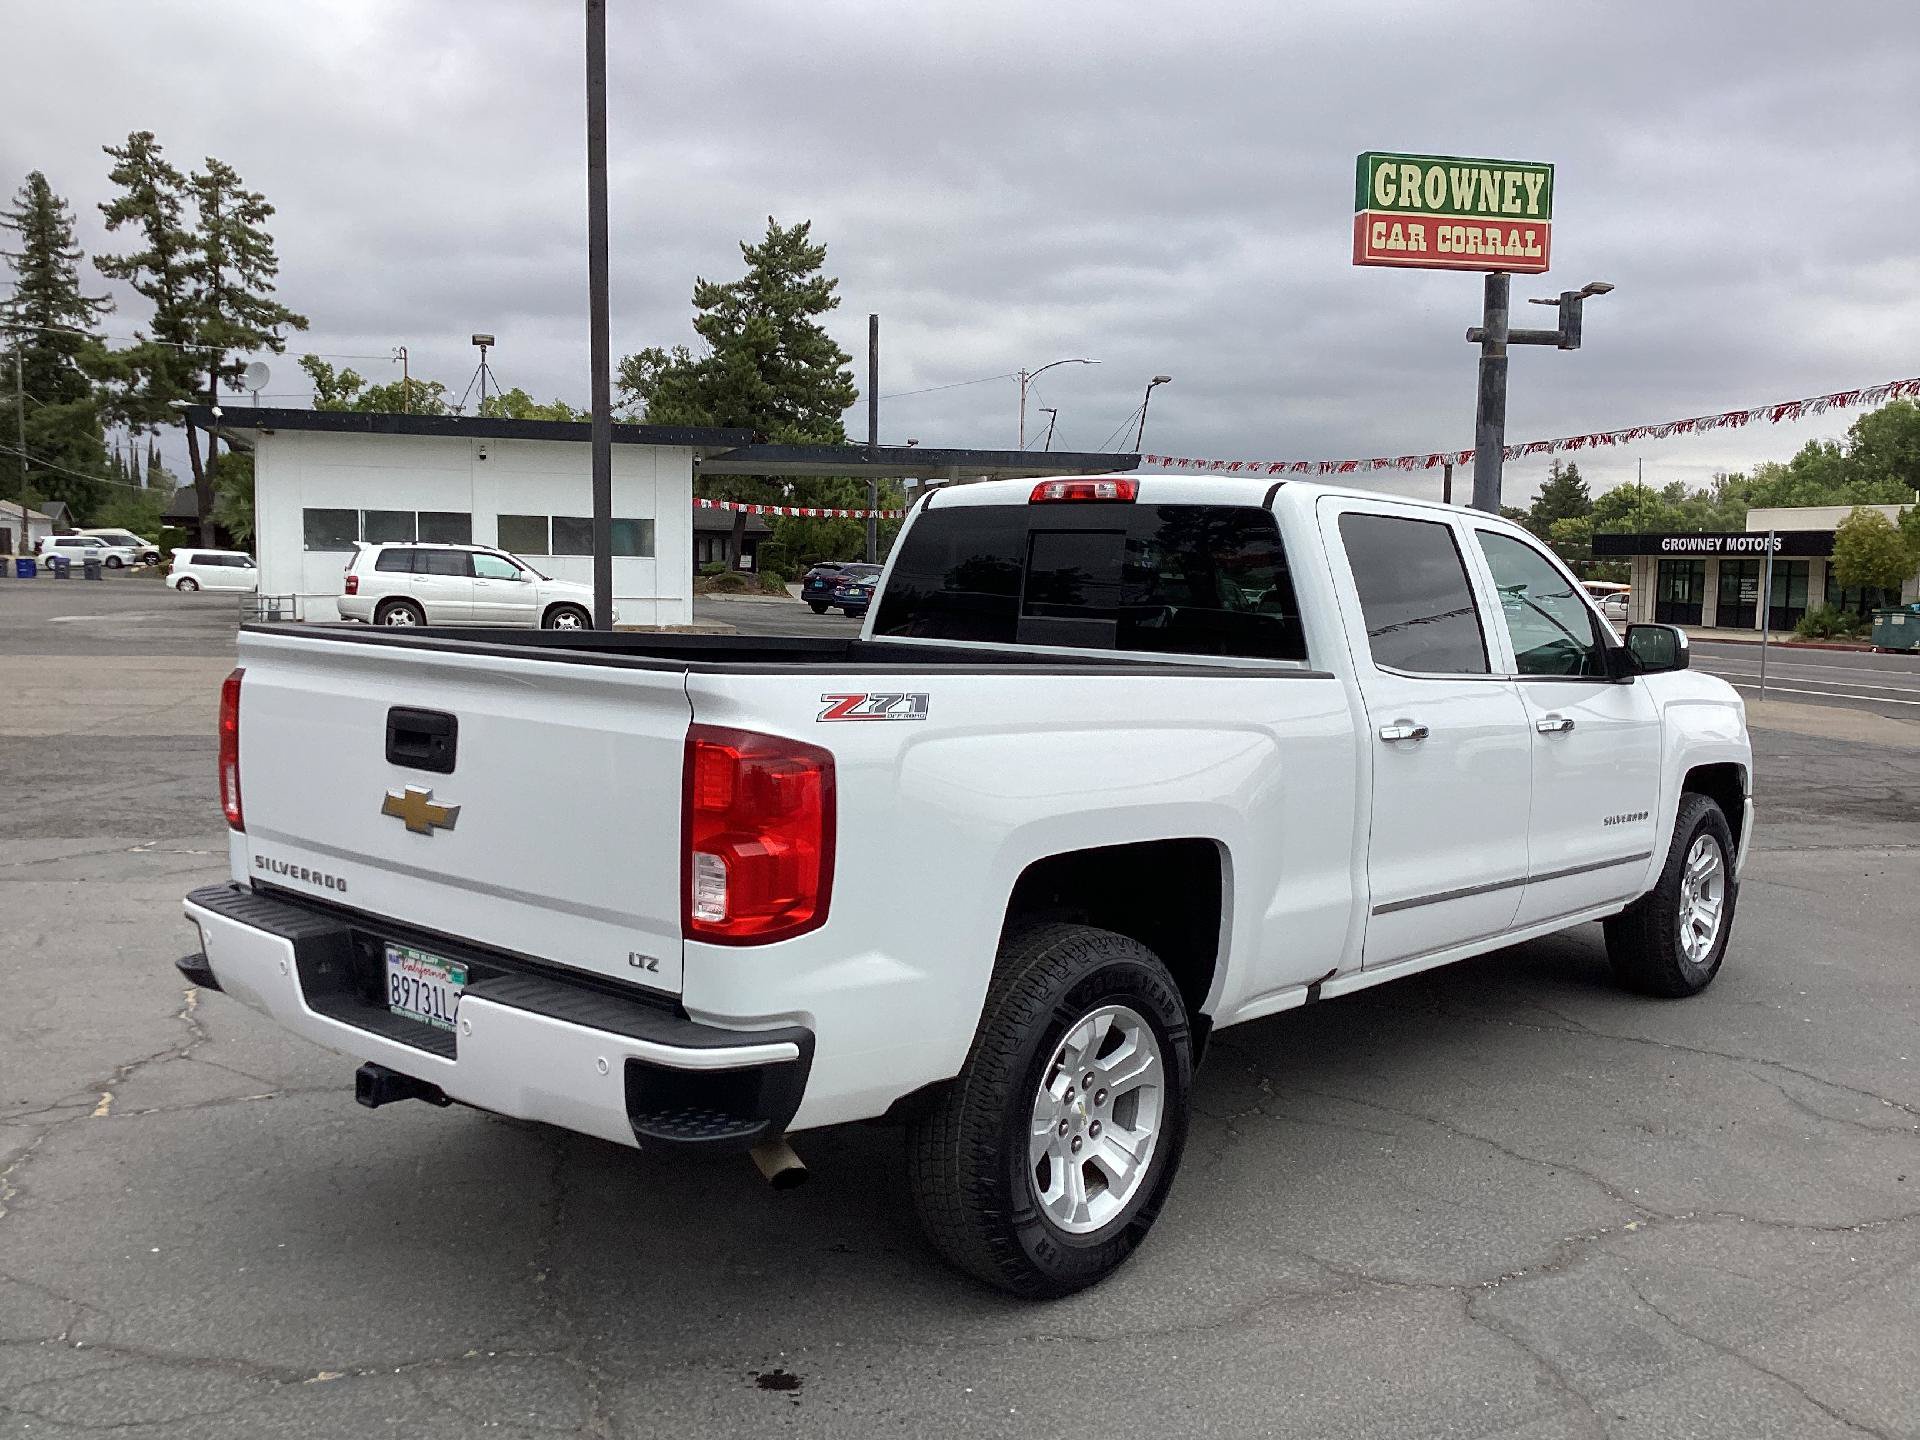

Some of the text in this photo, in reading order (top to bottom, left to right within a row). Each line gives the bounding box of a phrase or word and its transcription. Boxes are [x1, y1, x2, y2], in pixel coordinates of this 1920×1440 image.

[1374, 162, 1545, 215] GROWNEY
[1372, 221, 1541, 257] CAR CORRAL
[1661, 538, 1723, 551] GROWNEY
[816, 692, 930, 722] Z71
[1603, 811, 1649, 827] SILVERADO
[255, 855, 347, 892] SILVERADO
[628, 951, 660, 973] LTZ
